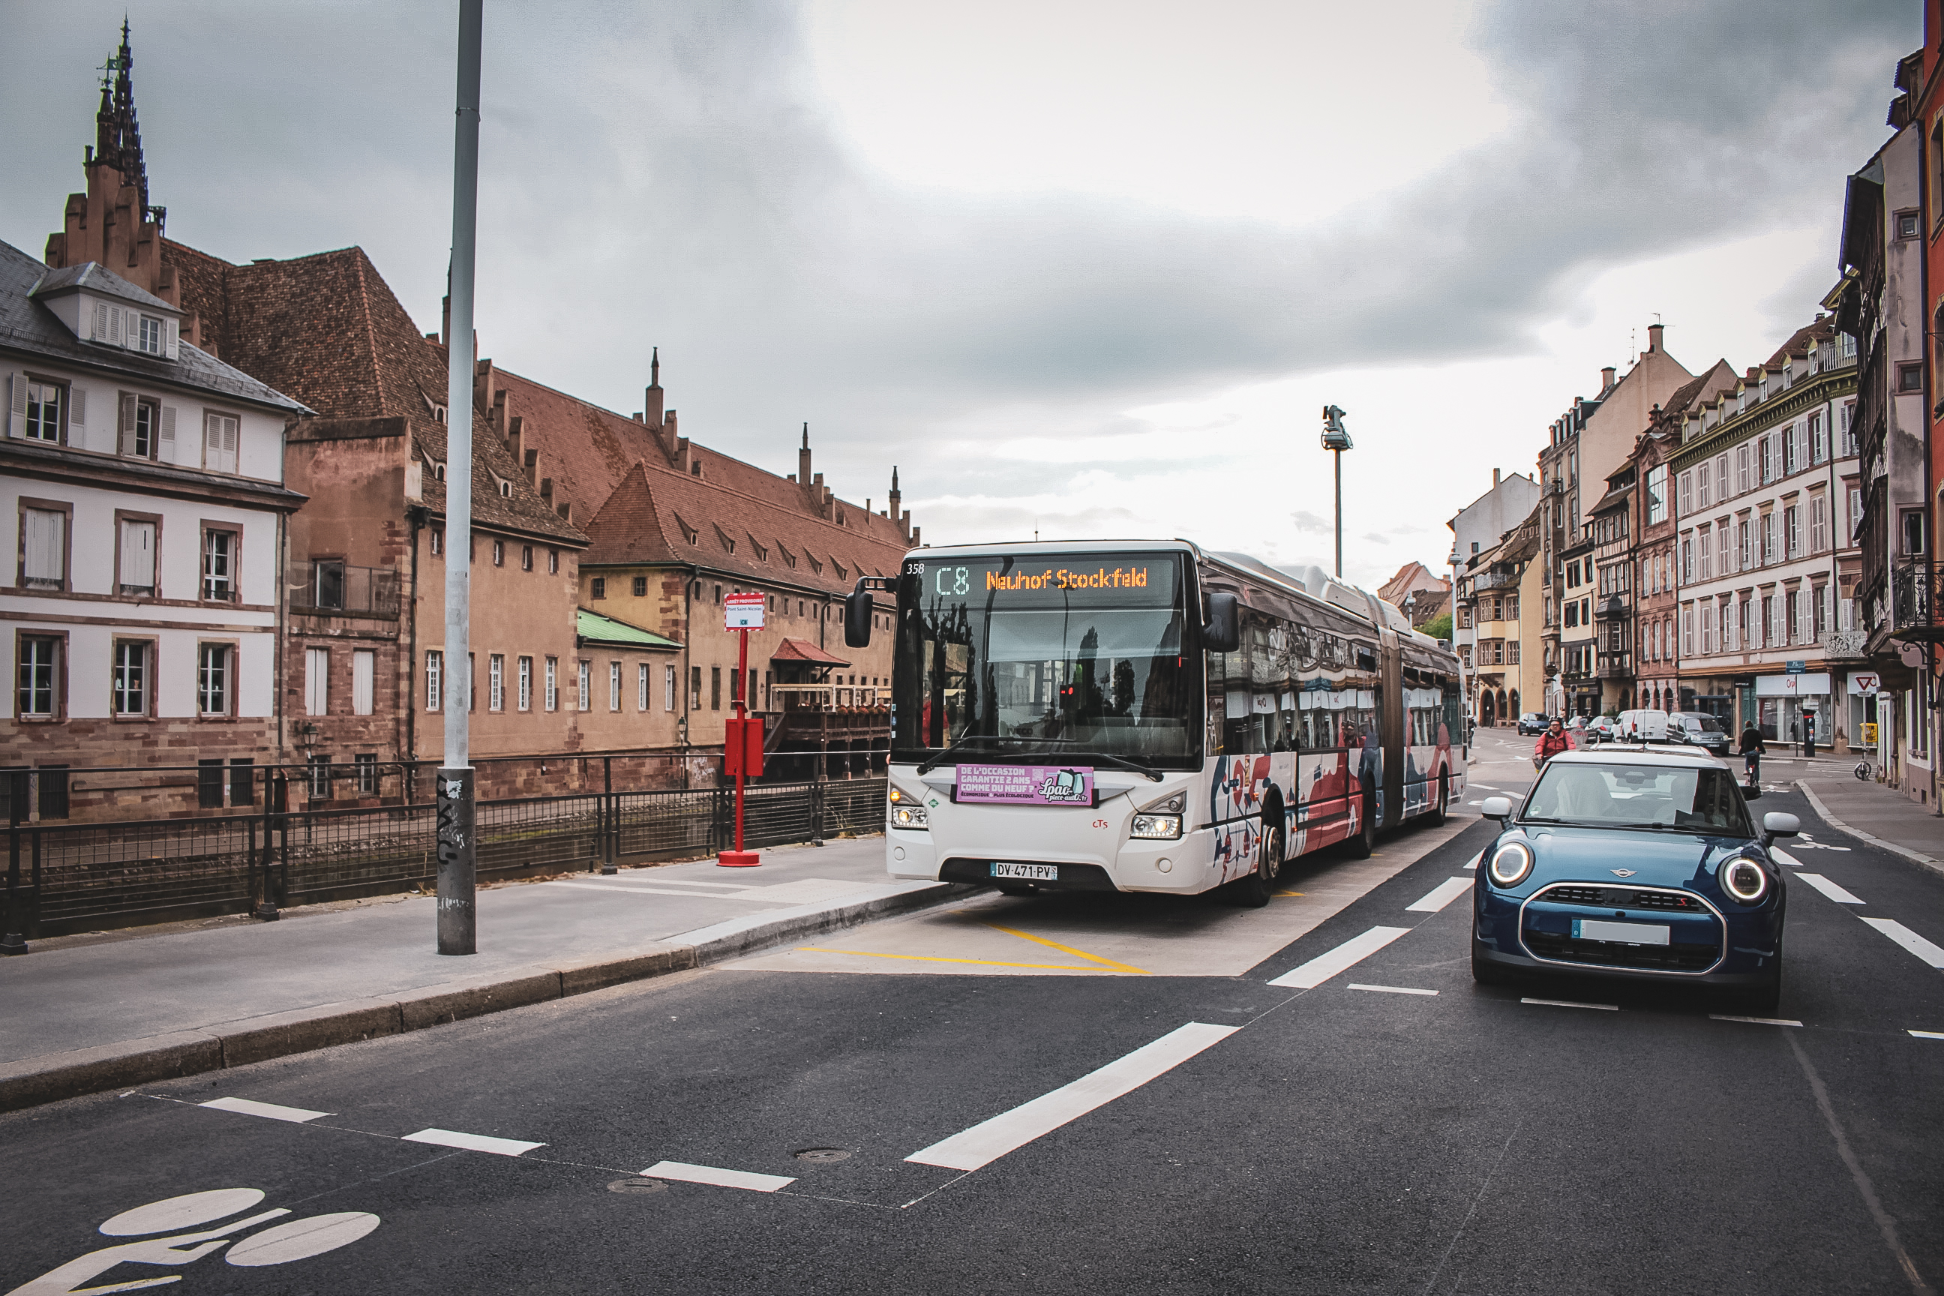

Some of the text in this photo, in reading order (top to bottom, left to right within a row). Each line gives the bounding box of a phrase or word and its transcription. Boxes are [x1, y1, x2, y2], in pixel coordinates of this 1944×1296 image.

[906, 563, 925, 575] 358
[936, 566, 1147, 596] C8 Neuhof Stockfeld
[1786, 678, 1797, 689] Orp
[974, 767, 1025, 776] L'OCCASION
[961, 776, 1005, 784] GARANTIE
[1012, 776, 1030, 784] ANS
[961, 784, 991, 792] COMME
[992, 784, 1004, 792] DU
[1005, 784, 1027, 792] NEUF
[997, 864, 1051, 878] DV-471-PV
